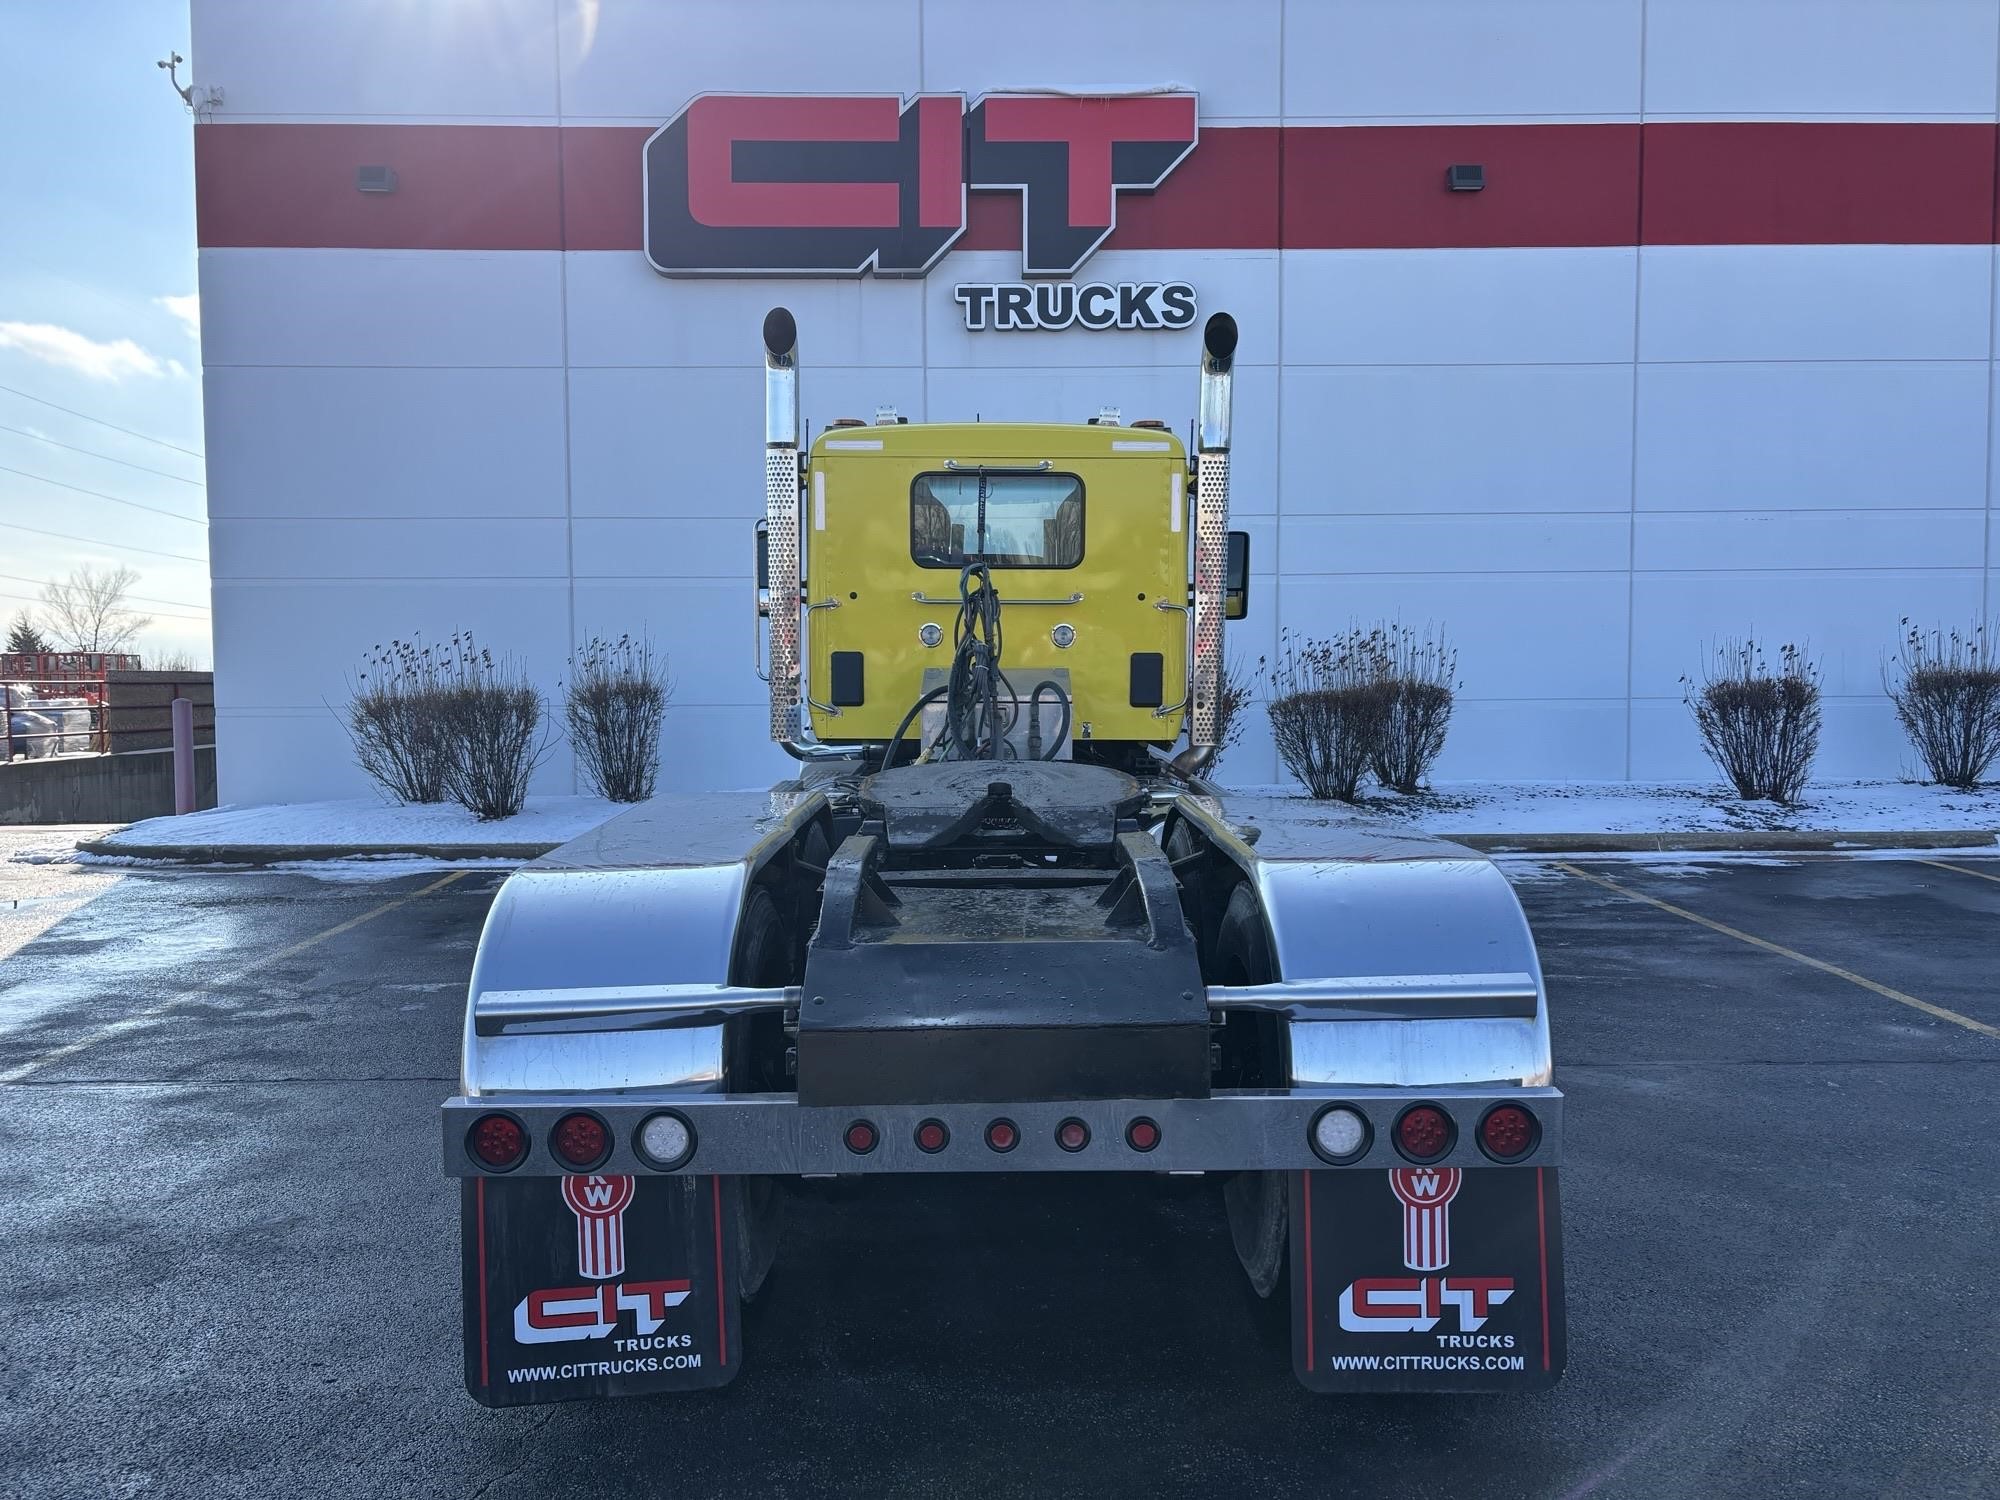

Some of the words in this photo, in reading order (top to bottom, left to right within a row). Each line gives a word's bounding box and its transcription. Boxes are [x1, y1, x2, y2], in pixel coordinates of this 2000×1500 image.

[643, 91, 1199, 278] CIT
[956, 284, 1197, 329] TRUCKS
[514, 1279, 691, 1344] CIT
[1338, 1277, 1515, 1332] CIT
[614, 1334, 692, 1352] TRUCKS
[1436, 1335, 1515, 1348] TRUCKS
[507, 1354, 701, 1383] WWW.CITTRUCKS.COM
[1332, 1356, 1524, 1371] WWW.CITTRUCKS.COM
